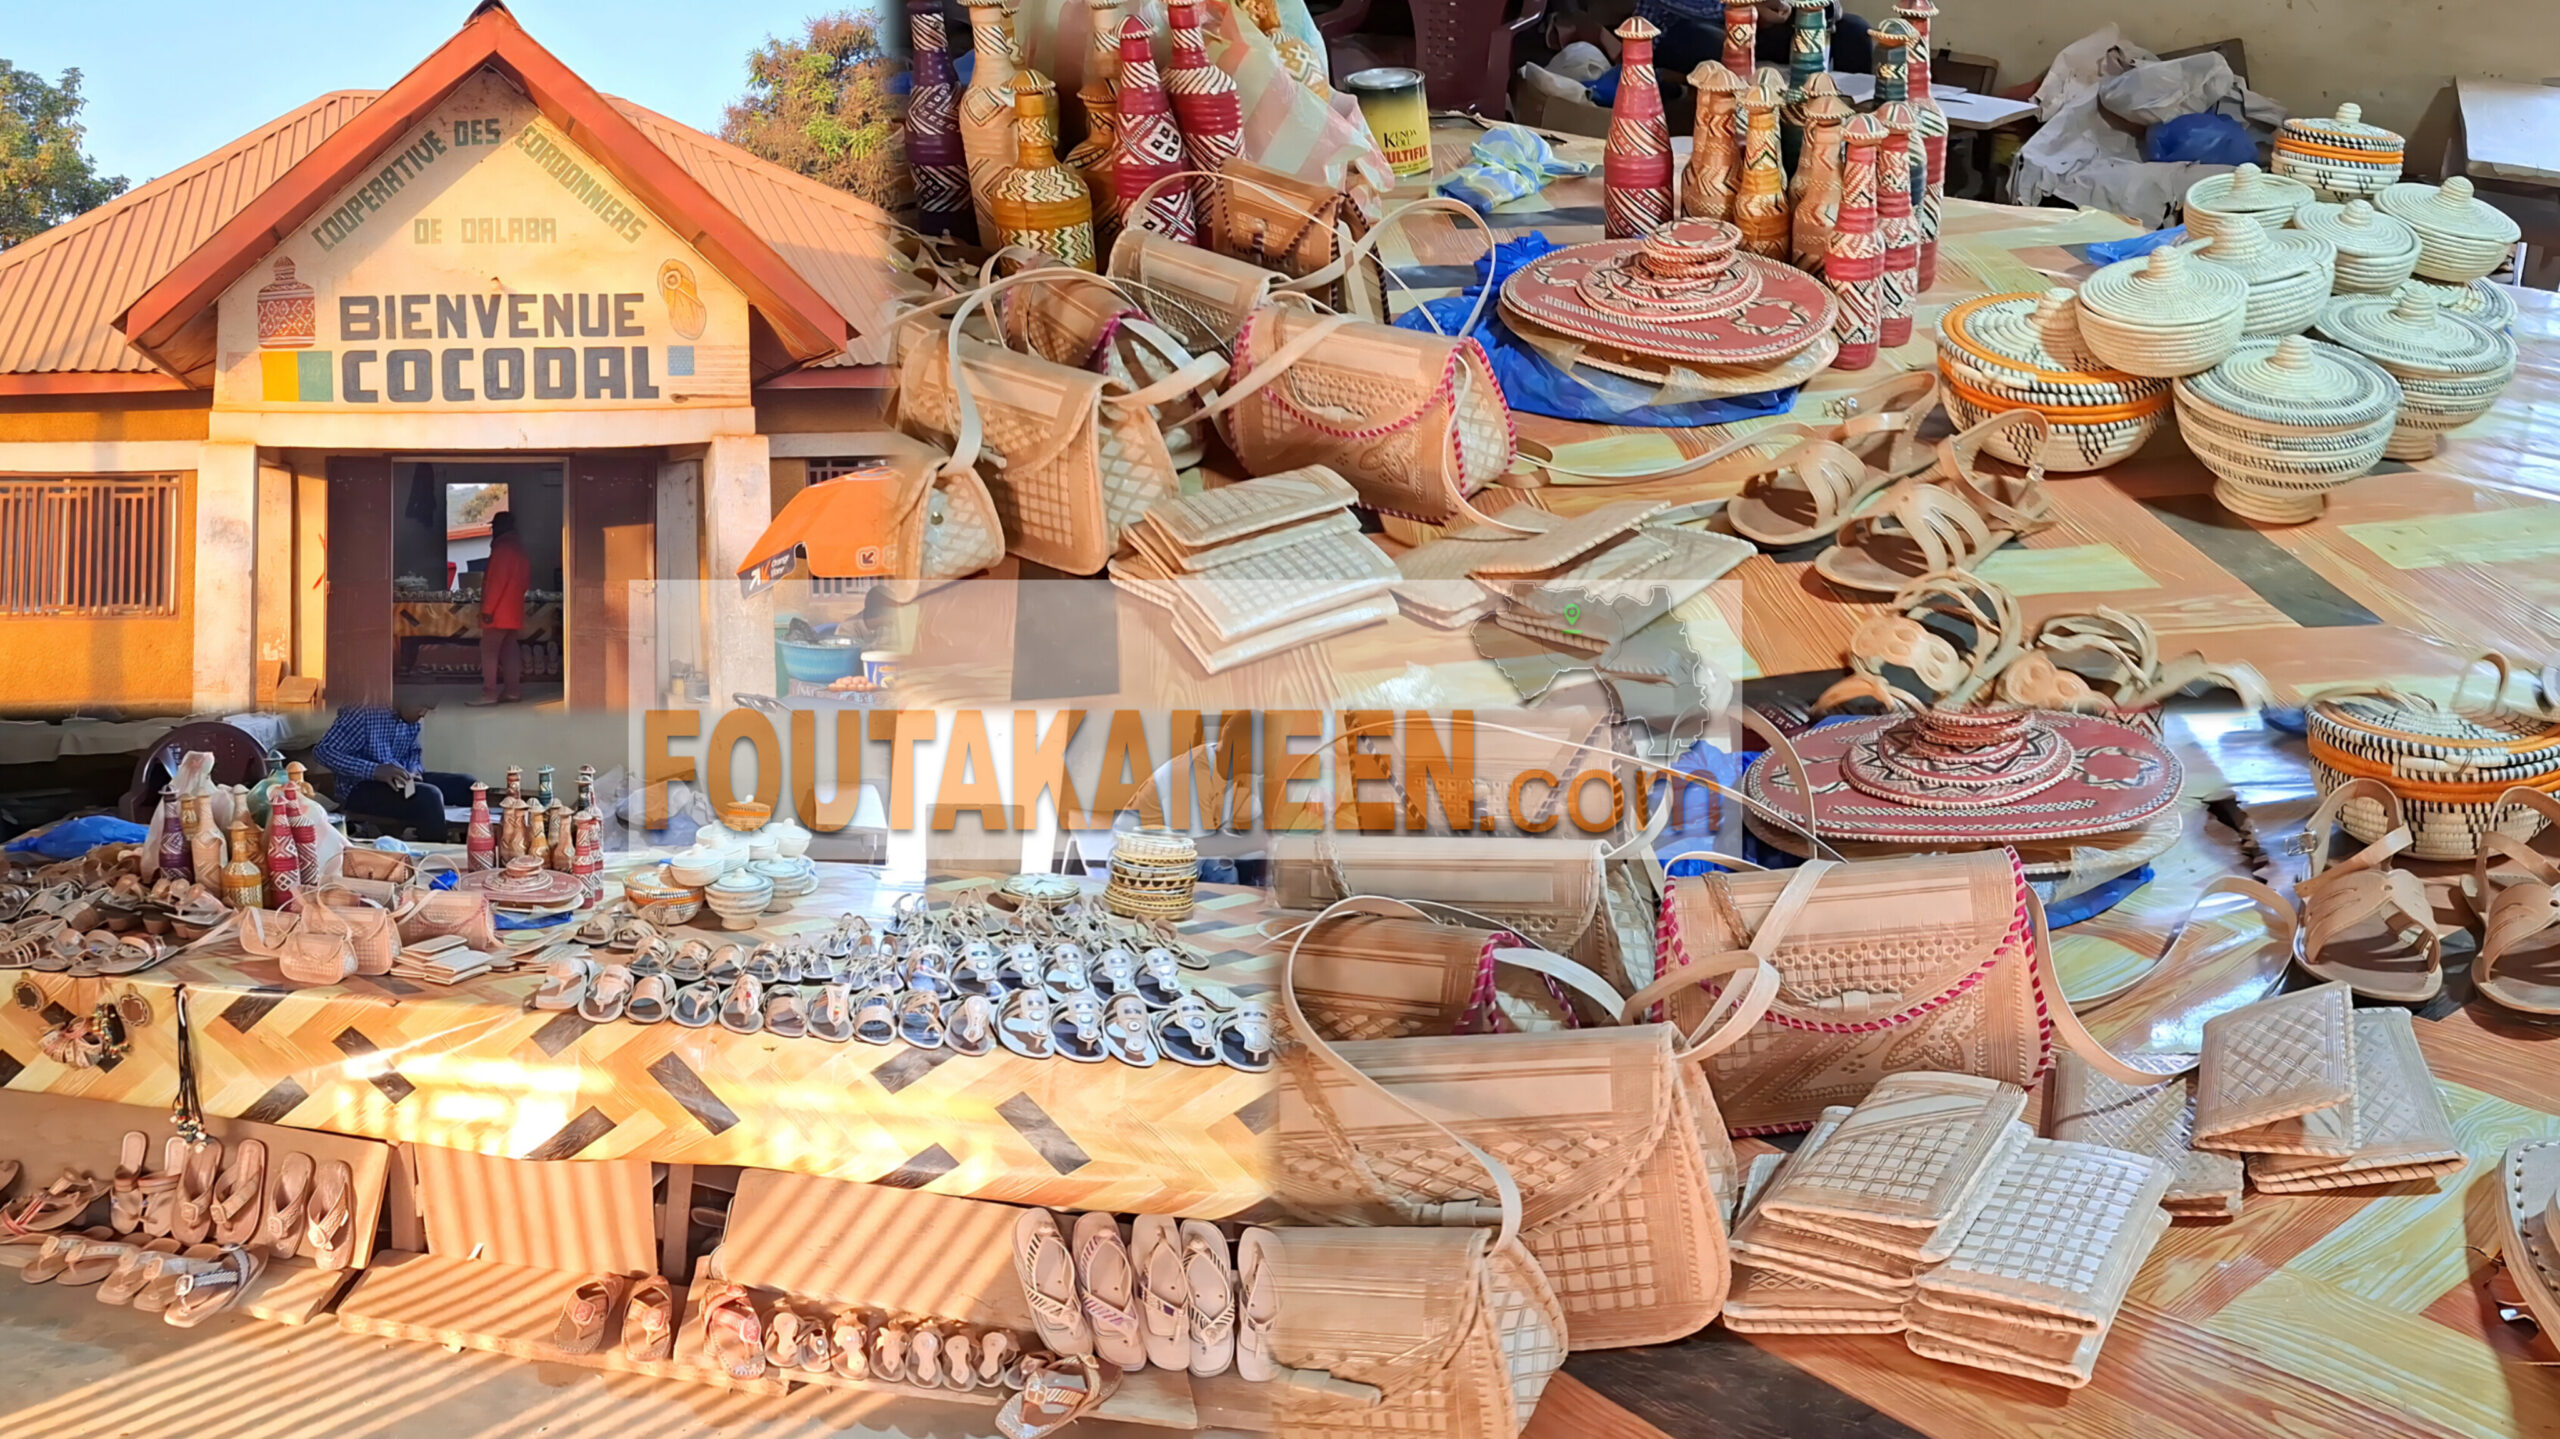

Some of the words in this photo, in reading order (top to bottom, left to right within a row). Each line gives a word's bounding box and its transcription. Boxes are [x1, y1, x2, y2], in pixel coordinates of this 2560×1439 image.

[311, 129, 447, 252] COOPERATIVE
[454, 118, 500, 147] DES
[514, 125, 648, 243] CORDONNIERS
[414, 218, 442, 244] DE
[461, 217, 557, 244] DALABA
[339, 293, 645, 341] BIENVENUE
[341, 346, 660, 403] COCODAL
